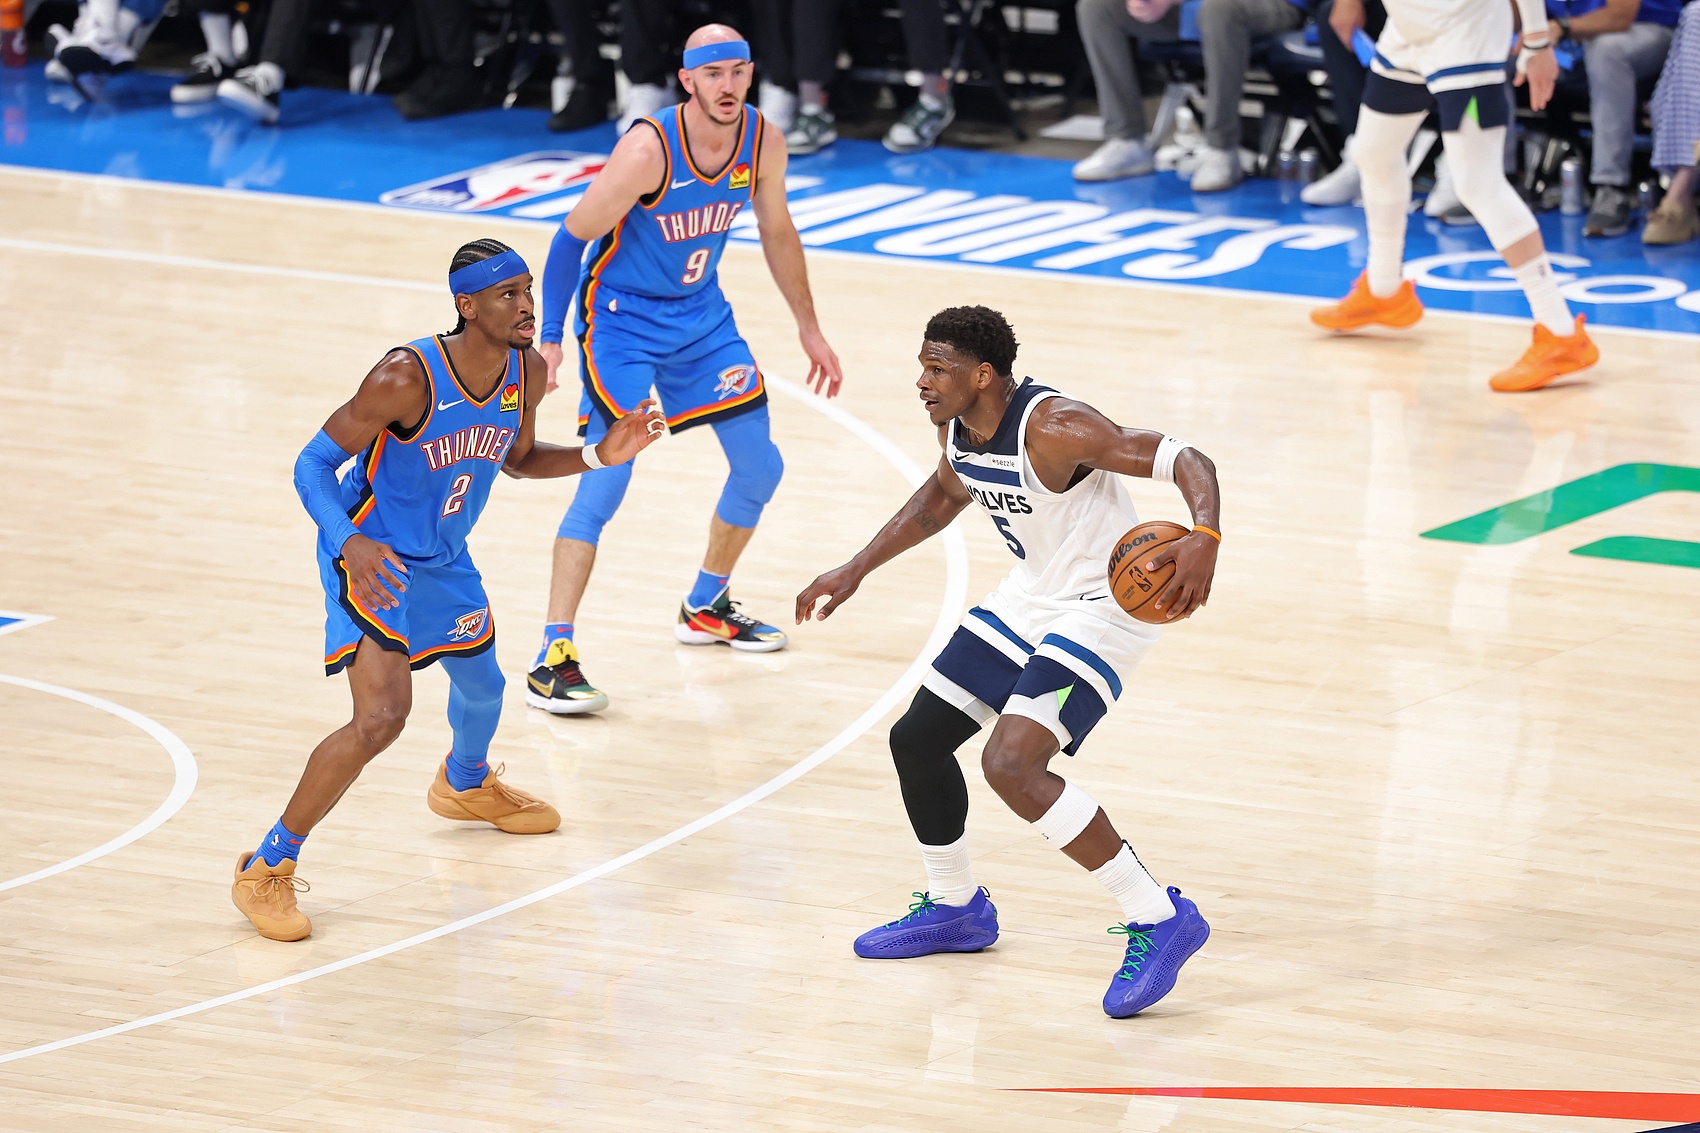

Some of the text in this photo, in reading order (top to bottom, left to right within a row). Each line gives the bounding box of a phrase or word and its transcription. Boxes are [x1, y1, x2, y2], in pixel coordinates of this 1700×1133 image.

[681, 248, 711, 285] 9
[996, 459, 1015, 467] sezzle
[441, 473, 473, 518] 2
[991, 514, 1026, 560] 5
